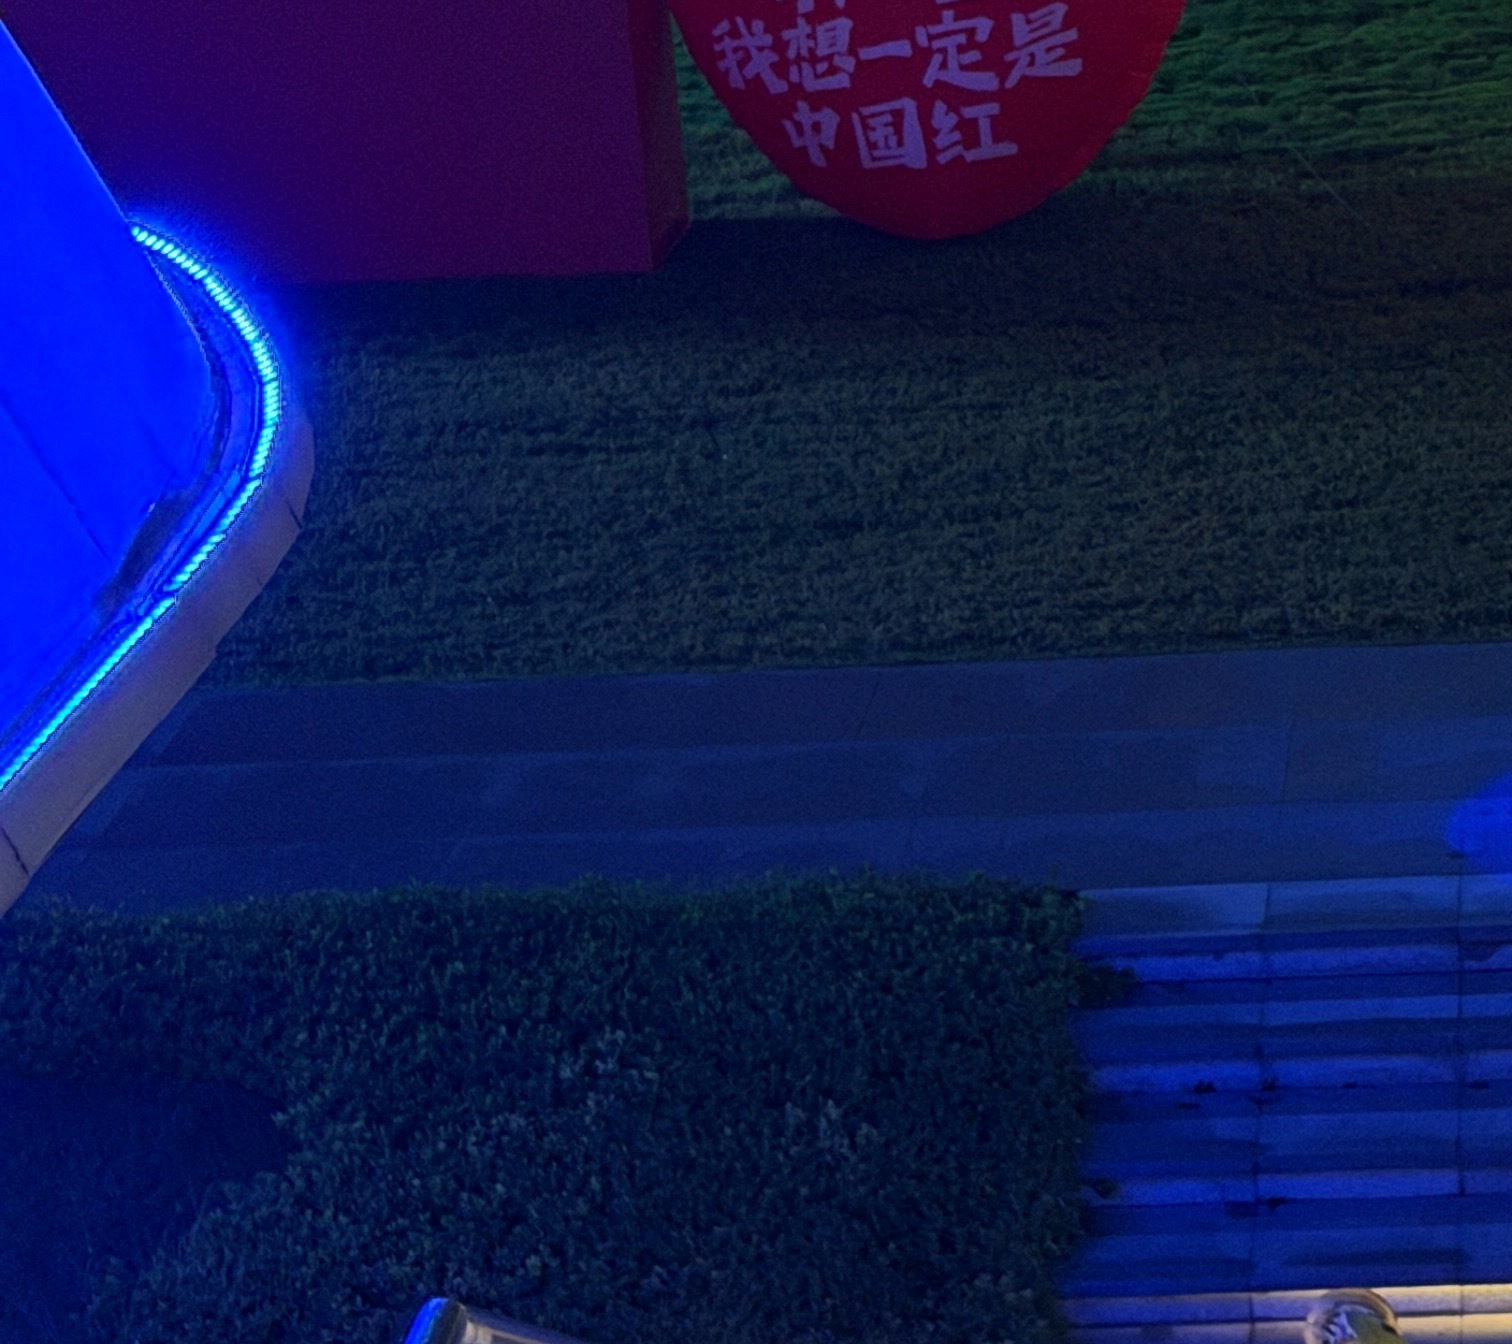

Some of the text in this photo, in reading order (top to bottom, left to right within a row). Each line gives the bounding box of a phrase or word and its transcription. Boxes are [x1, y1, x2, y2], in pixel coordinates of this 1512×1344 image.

[711, 2, 1083, 94] 我想一定是
[782, 97, 1018, 169] 中国红
